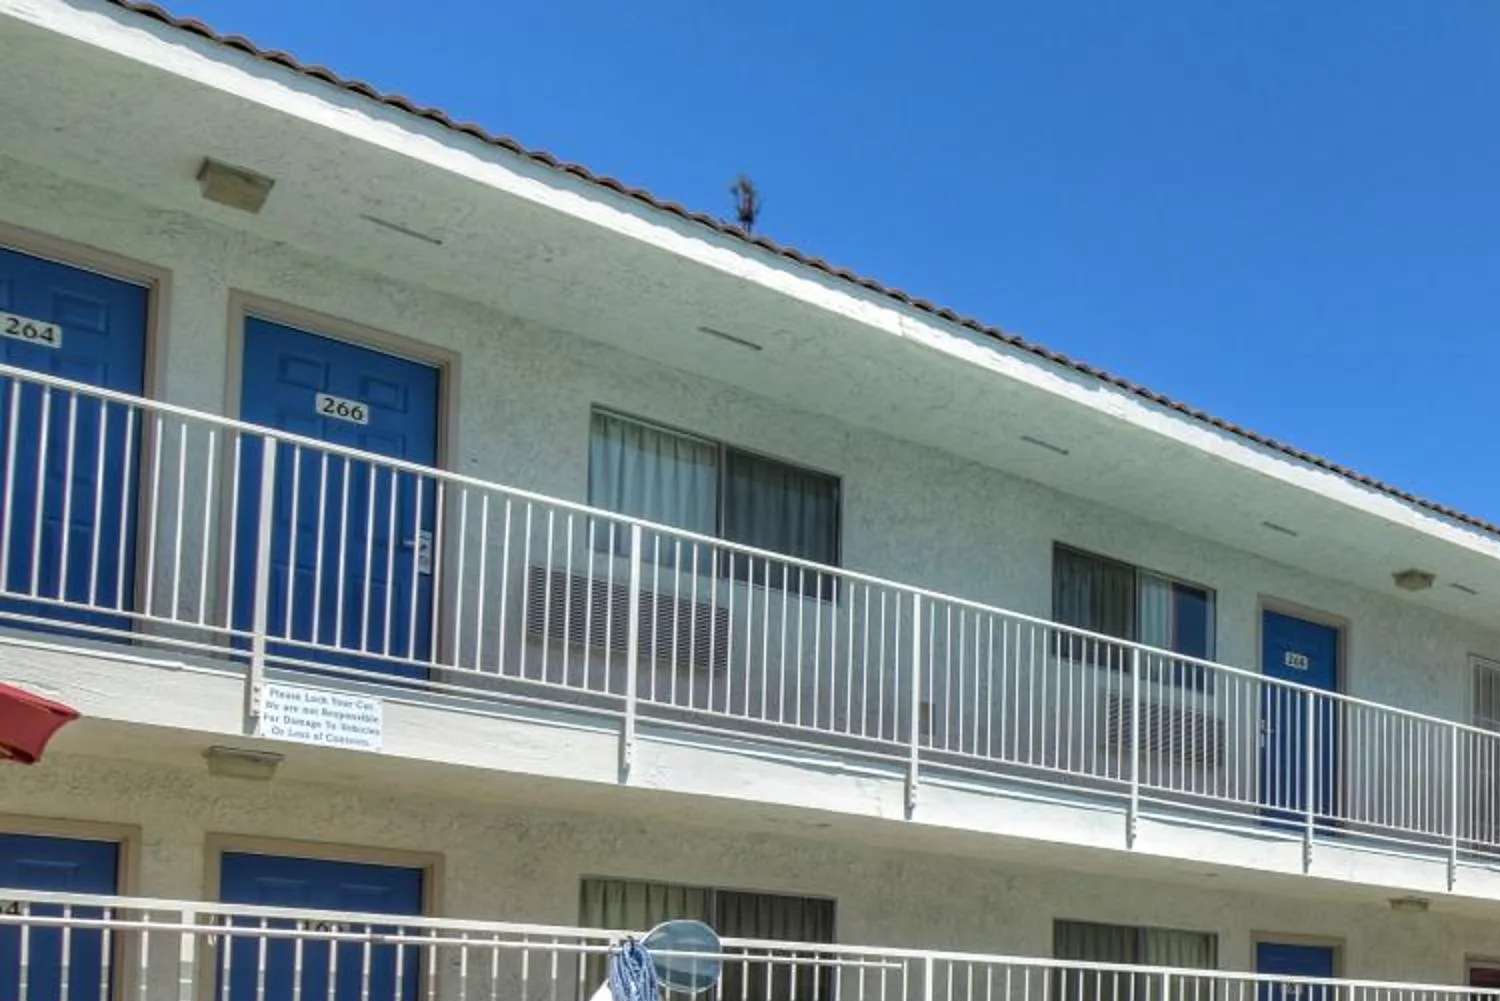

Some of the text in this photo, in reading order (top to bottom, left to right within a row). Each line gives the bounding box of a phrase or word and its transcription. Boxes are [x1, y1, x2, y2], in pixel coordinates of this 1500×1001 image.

[5, 317, 54, 343] 264
[322, 397, 363, 421] 266
[269, 687, 301, 701] Please
[305, 692, 328, 704] Lock
[332, 696, 353, 708] Your
[283, 715, 322, 730] Damage
[321, 707, 379, 723] Responsible
